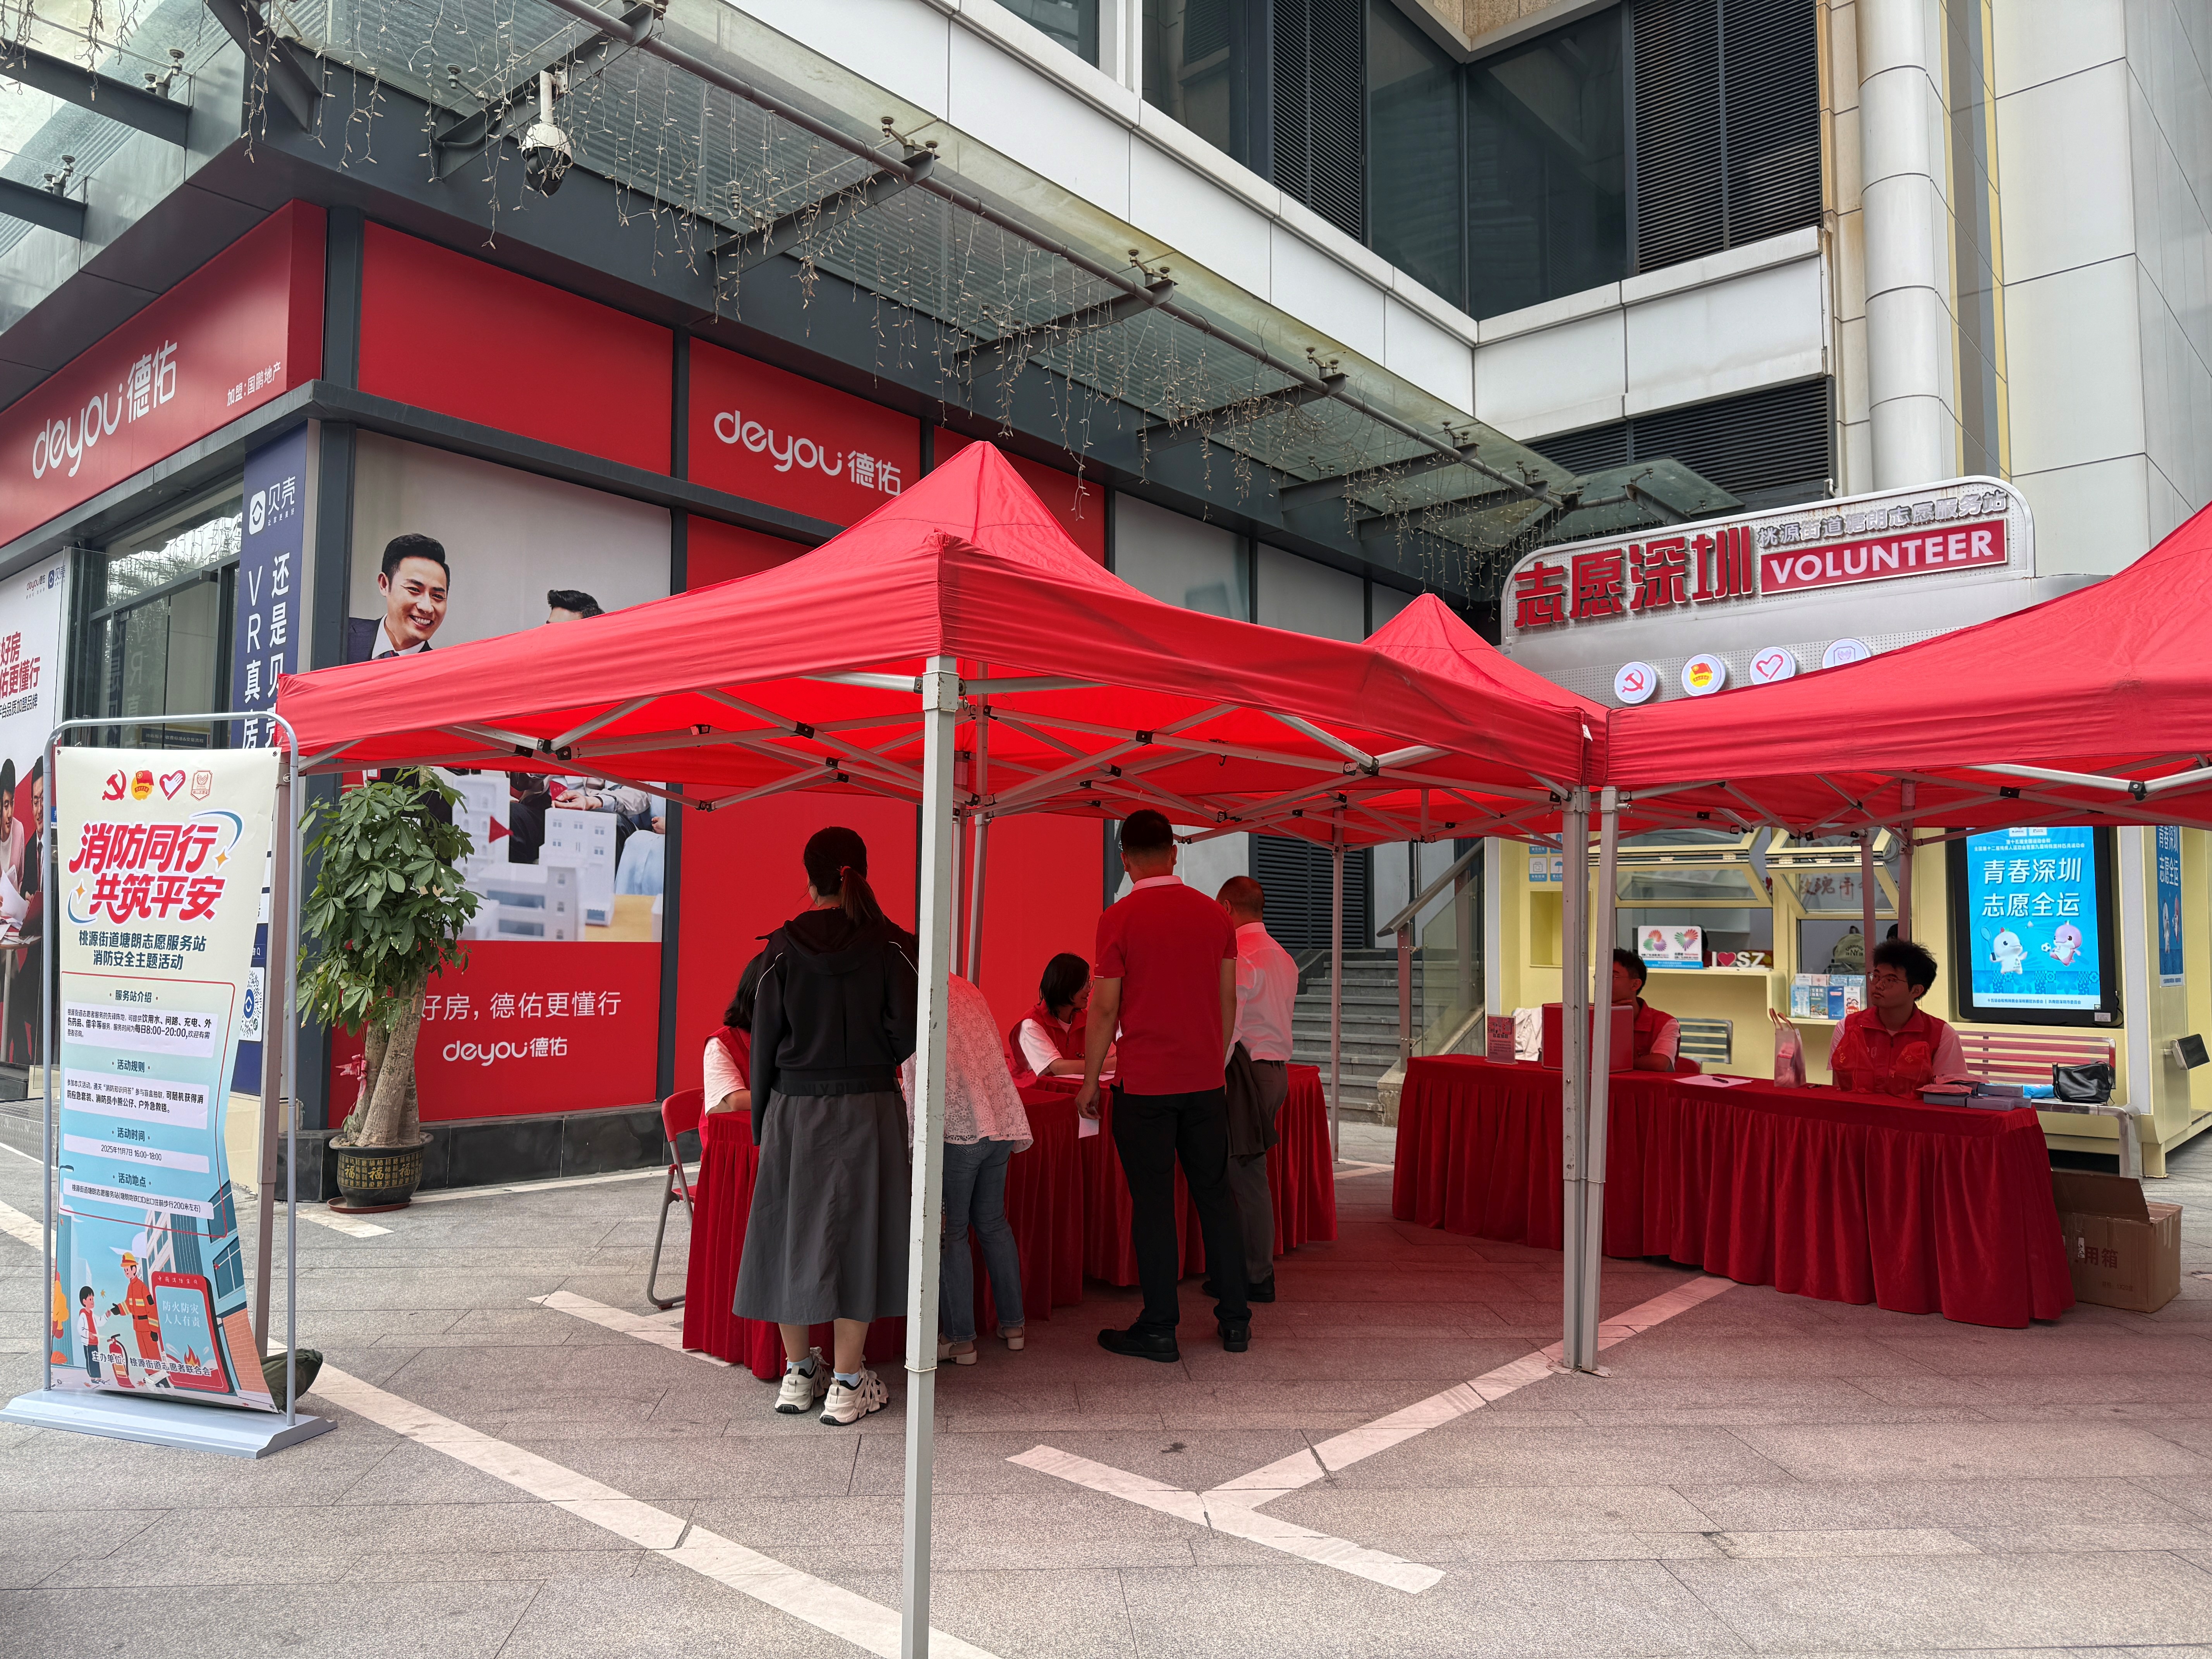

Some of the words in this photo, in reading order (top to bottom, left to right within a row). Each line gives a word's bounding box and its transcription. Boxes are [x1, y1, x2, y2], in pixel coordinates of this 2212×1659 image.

[127, 340, 177, 423] 德佑
[847, 450, 900, 496] 德佑
[268, 476, 295, 515] 贝壳
[1758, 490, 2008, 548] 桃源街道塘朗志愿服务站
[1770, 530, 1994, 584] VOLUNTEER
[1515, 526, 1754, 628] 志愿深圳
[0, 631, 21, 666] 好房
[0, 657, 40, 699] 佑更懂行
[69, 822, 218, 874] 消防同行
[1983, 857, 2081, 884] 青春深圳
[89, 873, 226, 924] 共筑平安
[1982, 892, 2080, 917] 志愿全运
[79, 930, 207, 952] 桃源街道塘朗志愿服务站
[93, 951, 183, 970] 消防安全主题活动
[1736, 951, 1766, 968] SZ
[115, 990, 152, 1003] 服务站介绍
[529, 1037, 567, 1057] 德佑
[117, 1059, 145, 1072] 活动规则
[117, 1127, 145, 1141] 活动时间
[101, 1144, 132, 1156] 2025年11月7日
[134, 1151, 161, 1161] 16:00-18:00
[118, 1173, 146, 1187] 活动地点
[368, 1167, 384, 1180] 福
[2074, 1246, 2118, 1269] 用箱
[163, 1300, 199, 1314] 防火防灾
[165, 1313, 200, 1328] 人人有责
[130, 1357, 211, 1376] 桃源街道志愿者联合会
